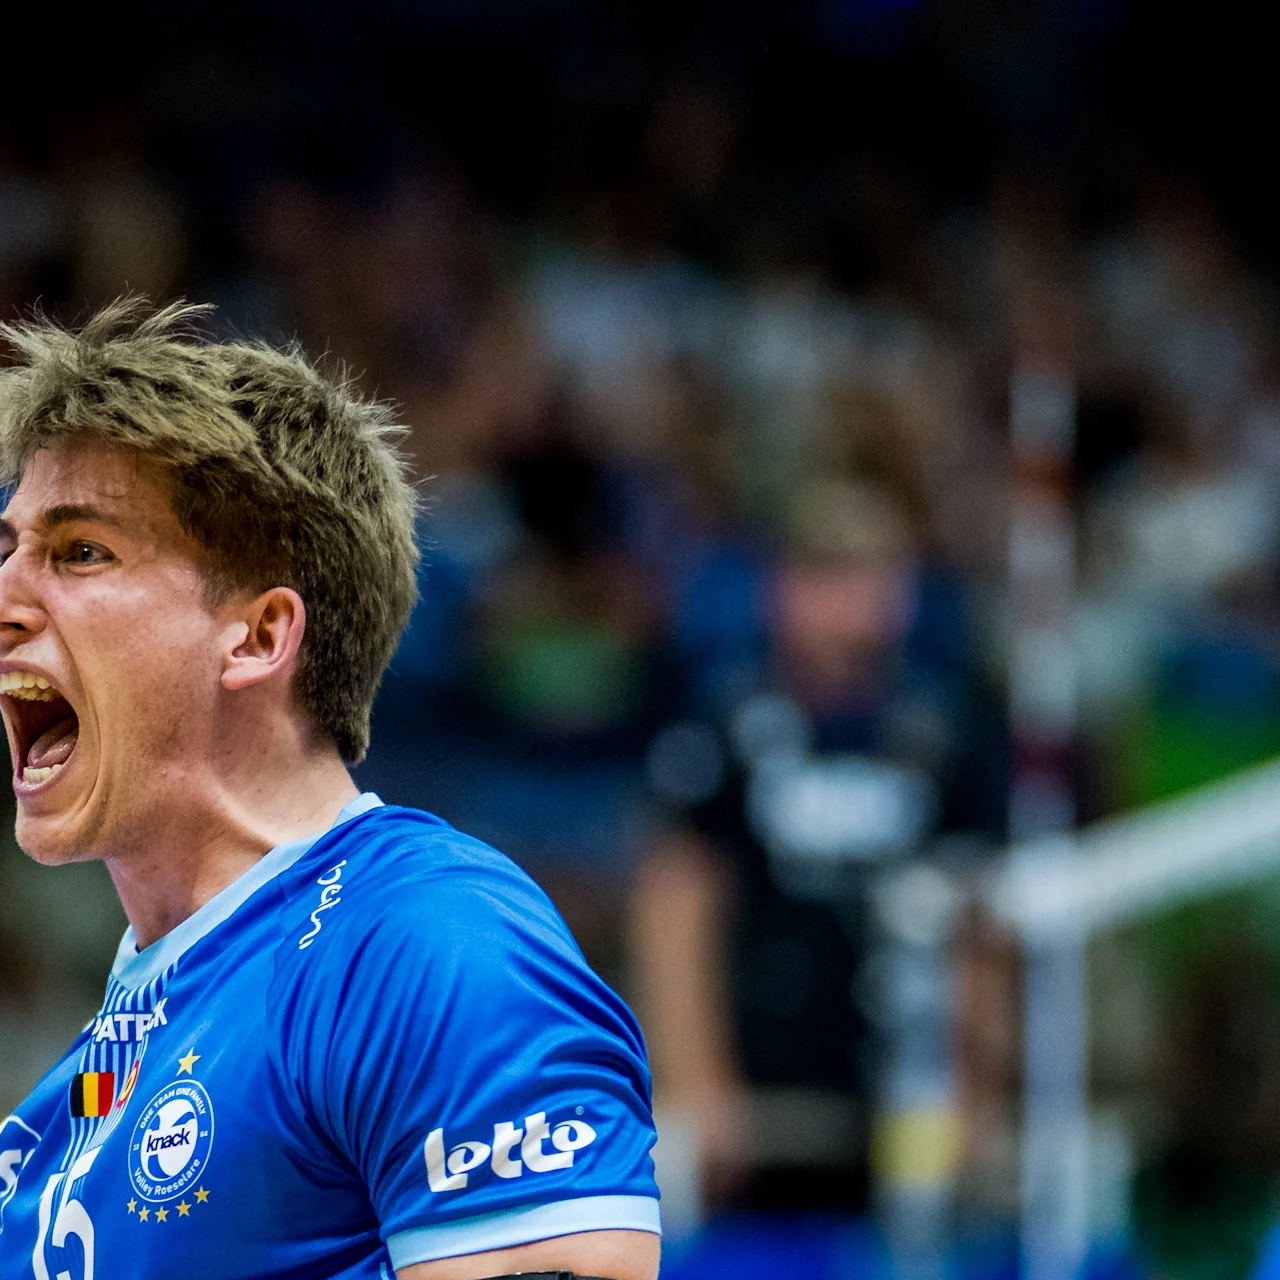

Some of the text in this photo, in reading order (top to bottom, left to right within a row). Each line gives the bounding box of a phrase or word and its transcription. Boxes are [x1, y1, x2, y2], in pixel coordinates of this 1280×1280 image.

[140, 1087, 206, 1129] ONE TEAM ONE FAMILY
[146, 1127, 191, 1153] knack
[424, 1111, 597, 1193] Lotto
[134, 1158, 200, 1196] Volley Roeselare
